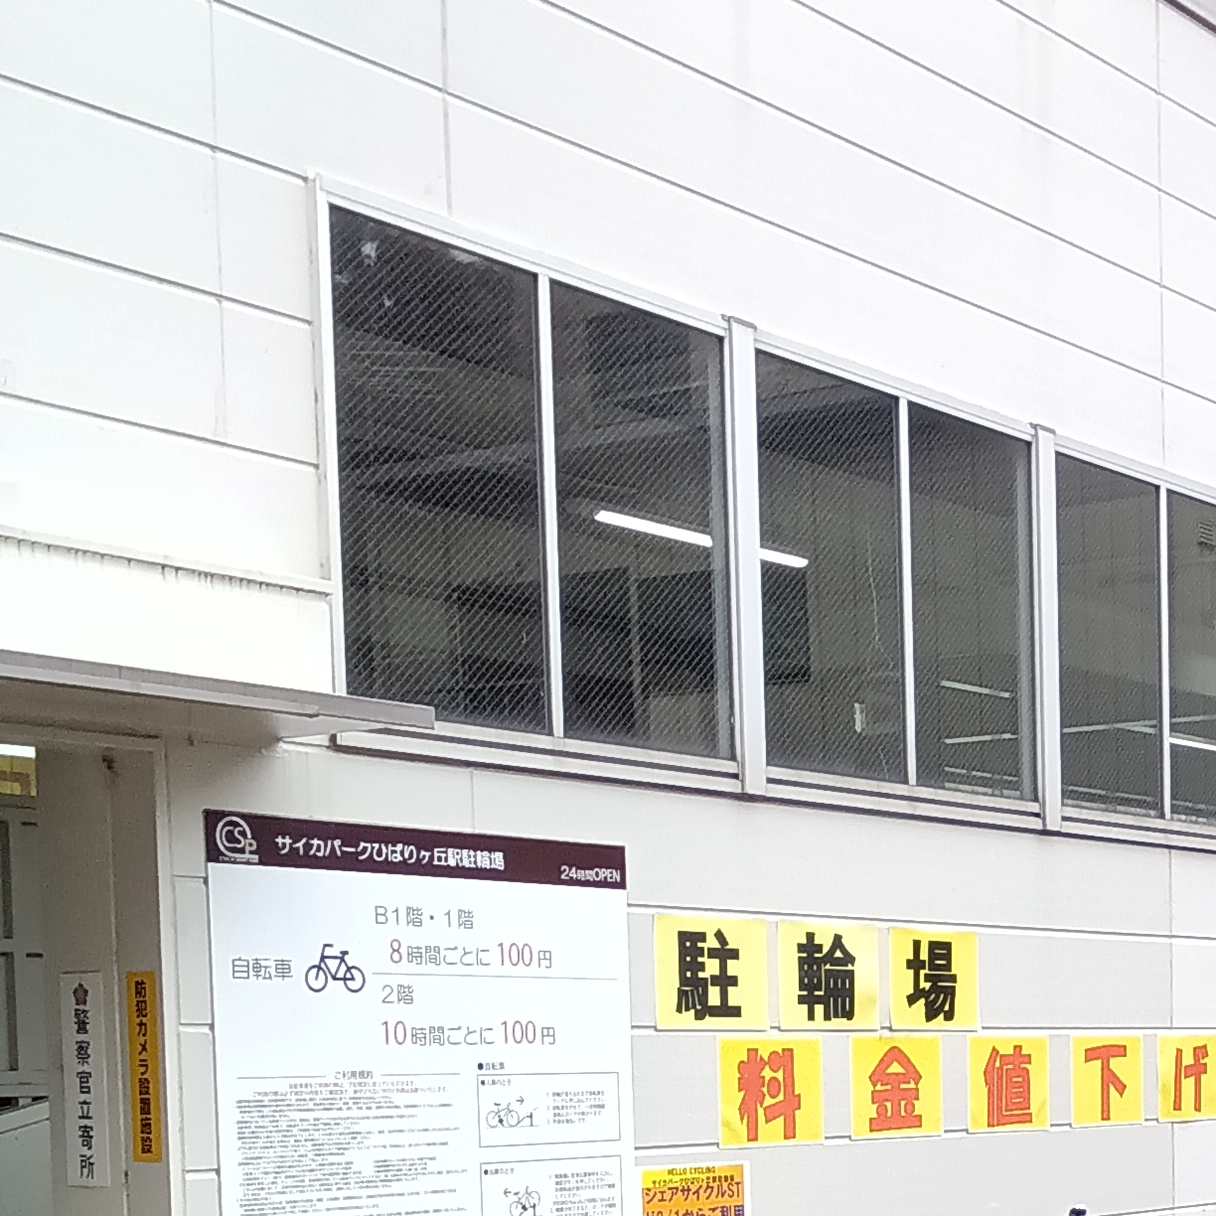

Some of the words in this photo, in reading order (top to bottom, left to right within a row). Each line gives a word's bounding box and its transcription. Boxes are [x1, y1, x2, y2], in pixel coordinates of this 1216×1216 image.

[275, 834, 504, 870] サイカパークひばりヶ丘駅駐輪場
[561, 866, 620, 882] 24時間OPEN
[232, 957, 293, 981] 自転車
[676, 931, 957, 1022] 駐輪場
[382, 984, 414, 1004] 2階
[74, 1008, 95, 1180] 警察官立寄所
[737, 1043, 1208, 1142] 料金値下げ
[645, 1182, 741, 1204] シェアサイクルST
